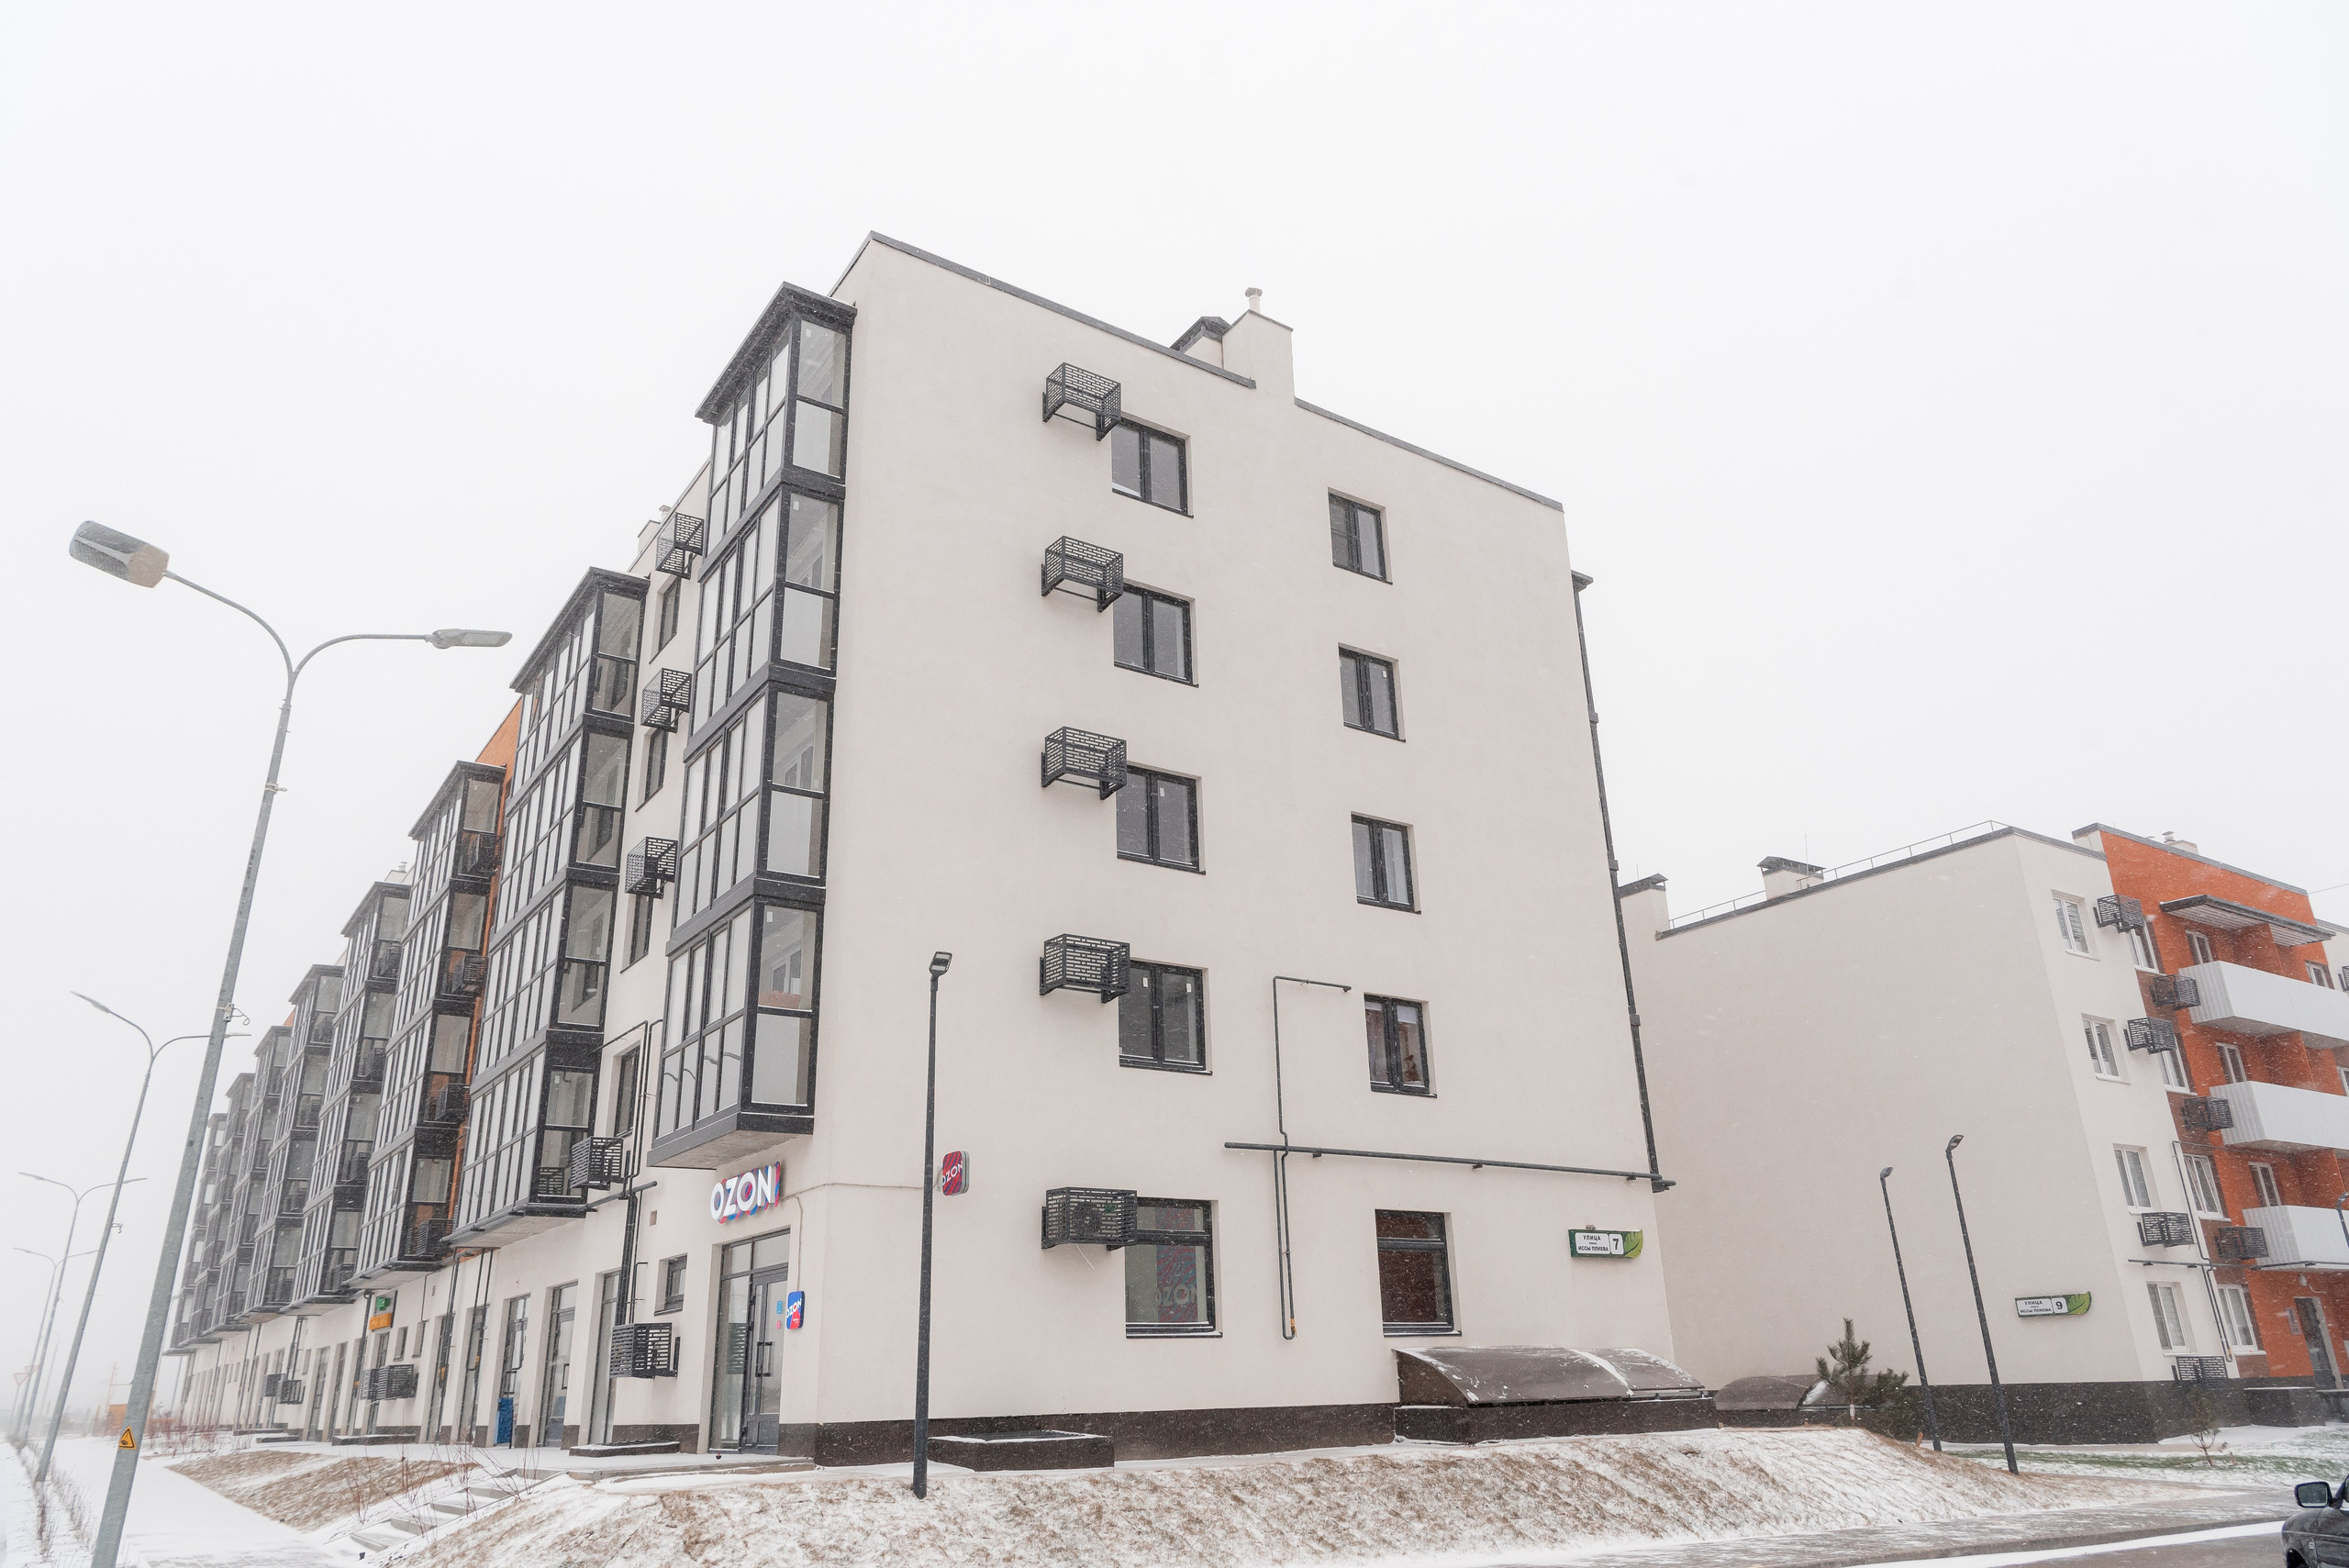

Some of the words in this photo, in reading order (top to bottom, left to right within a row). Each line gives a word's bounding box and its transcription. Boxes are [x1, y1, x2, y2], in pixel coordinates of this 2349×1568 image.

[942, 1160, 963, 1186] OZON
[710, 1164, 775, 1220] OZON
[1612, 1239, 1620, 1251] 7
[786, 1297, 802, 1318] OZON
[2055, 1301, 2063, 1310] 9
